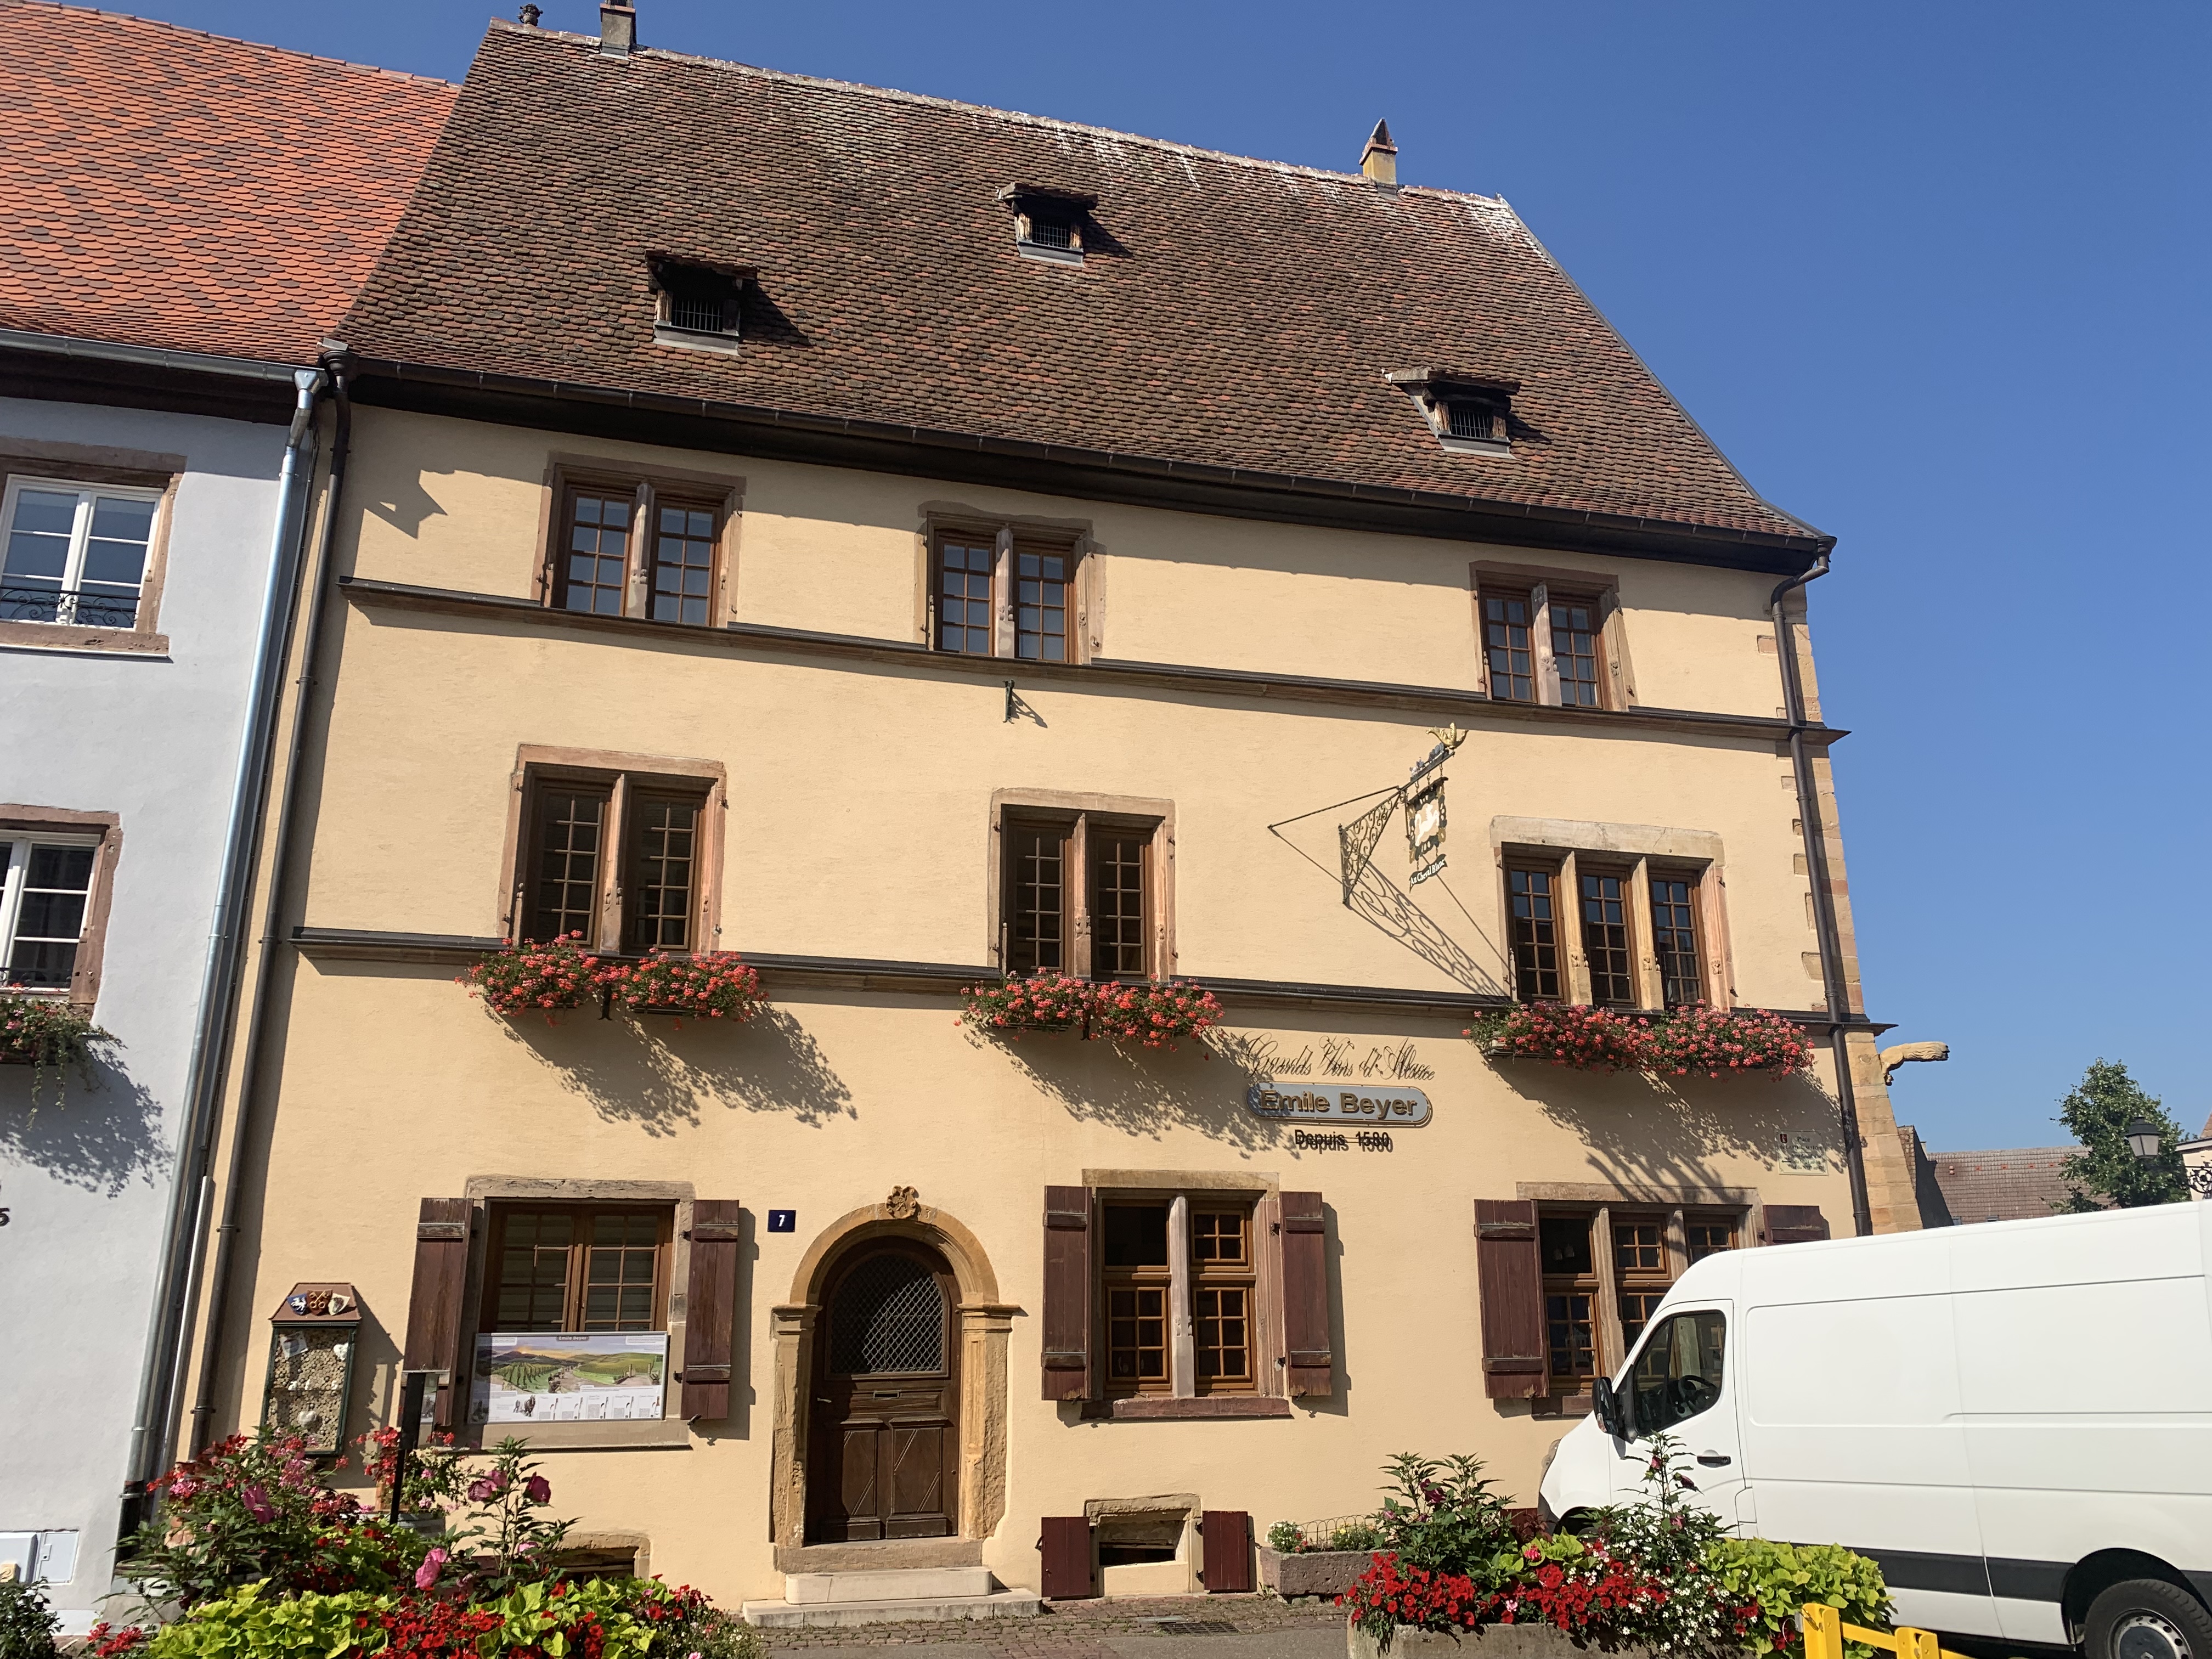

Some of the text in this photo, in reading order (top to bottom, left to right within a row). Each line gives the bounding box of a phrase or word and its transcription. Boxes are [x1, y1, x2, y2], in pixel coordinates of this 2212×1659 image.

[1410, 859, 1446, 887] Au Cheval Blanc
[1241, 1031, 1310, 1076] Grands
[1318, 1035, 1353, 1076] Vins
[1261, 1090, 1417, 1119] Emile Beyer
[1294, 1128, 1390, 1150] Depuis 1580
[778, 1214, 786, 1227] 7
